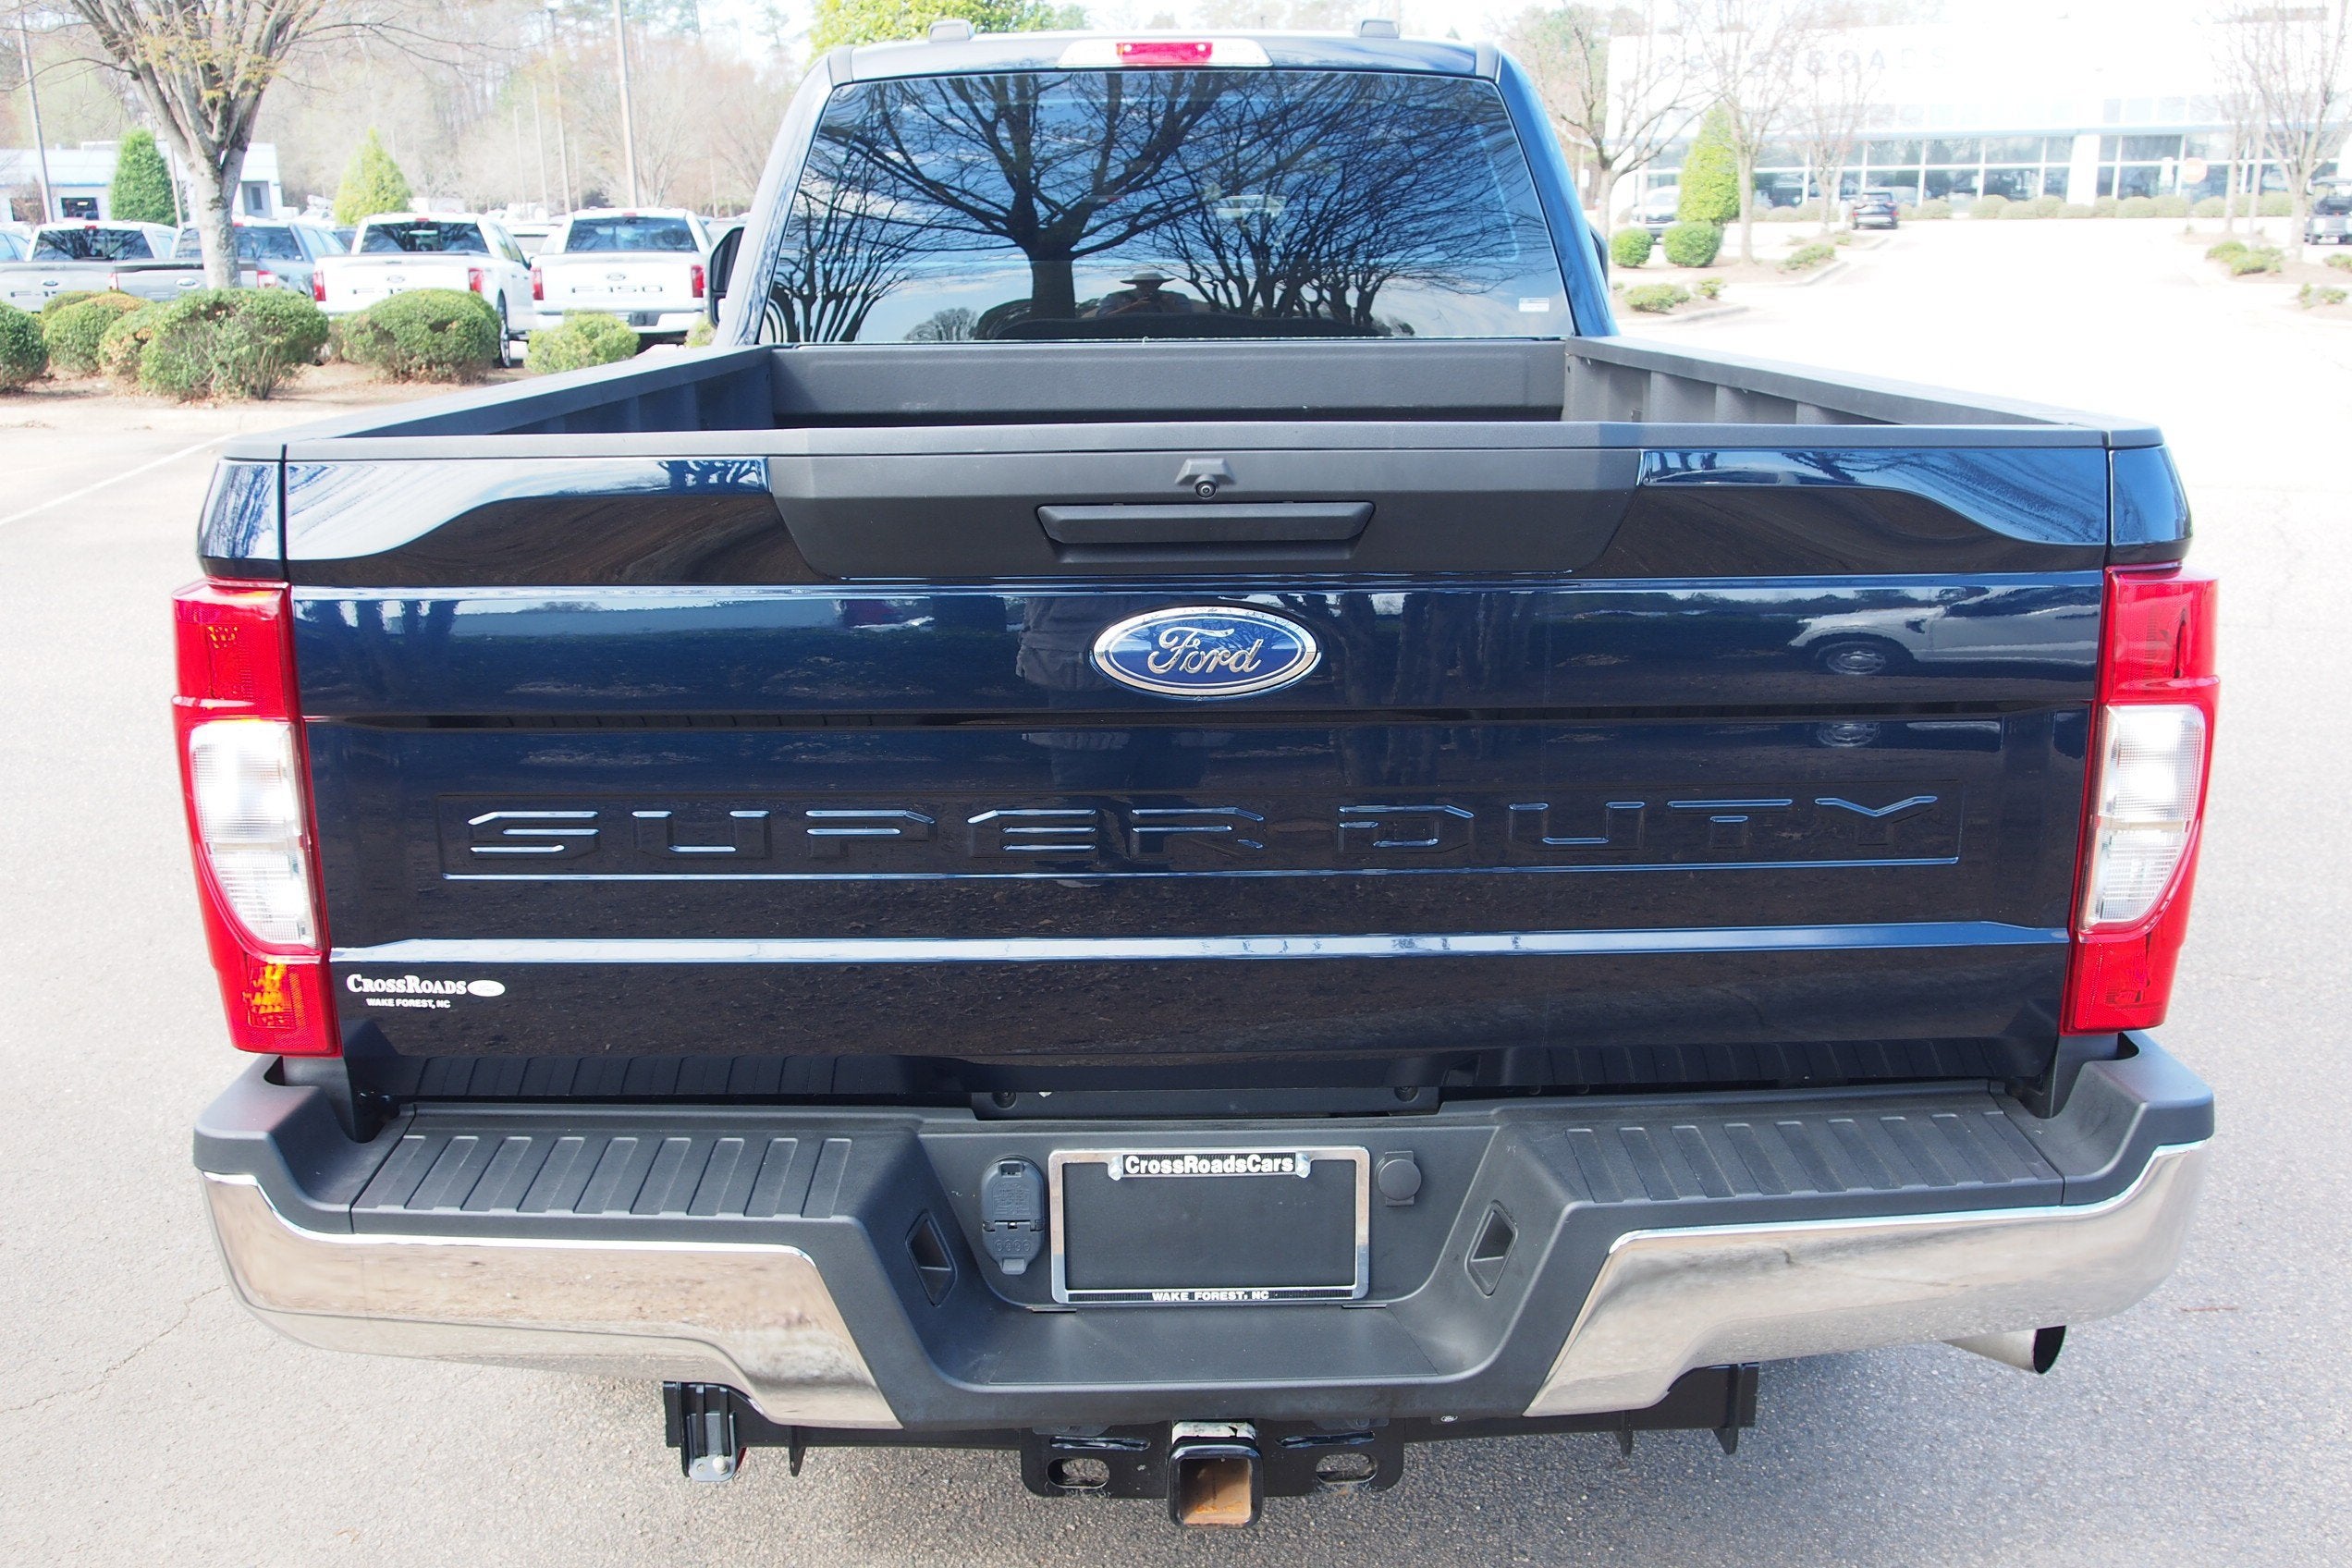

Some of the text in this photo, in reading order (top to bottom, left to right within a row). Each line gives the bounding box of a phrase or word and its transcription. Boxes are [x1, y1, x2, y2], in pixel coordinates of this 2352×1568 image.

[1147, 626, 1265, 675] Ford
[468, 795, 1938, 861] SUPER DUTY
[365, 998, 451, 1010] WAKE FOREST, NC
[1125, 1154, 1294, 1174] CrossRoadsCars
[1151, 1291, 1270, 1302] WAKE FOREST, NC
